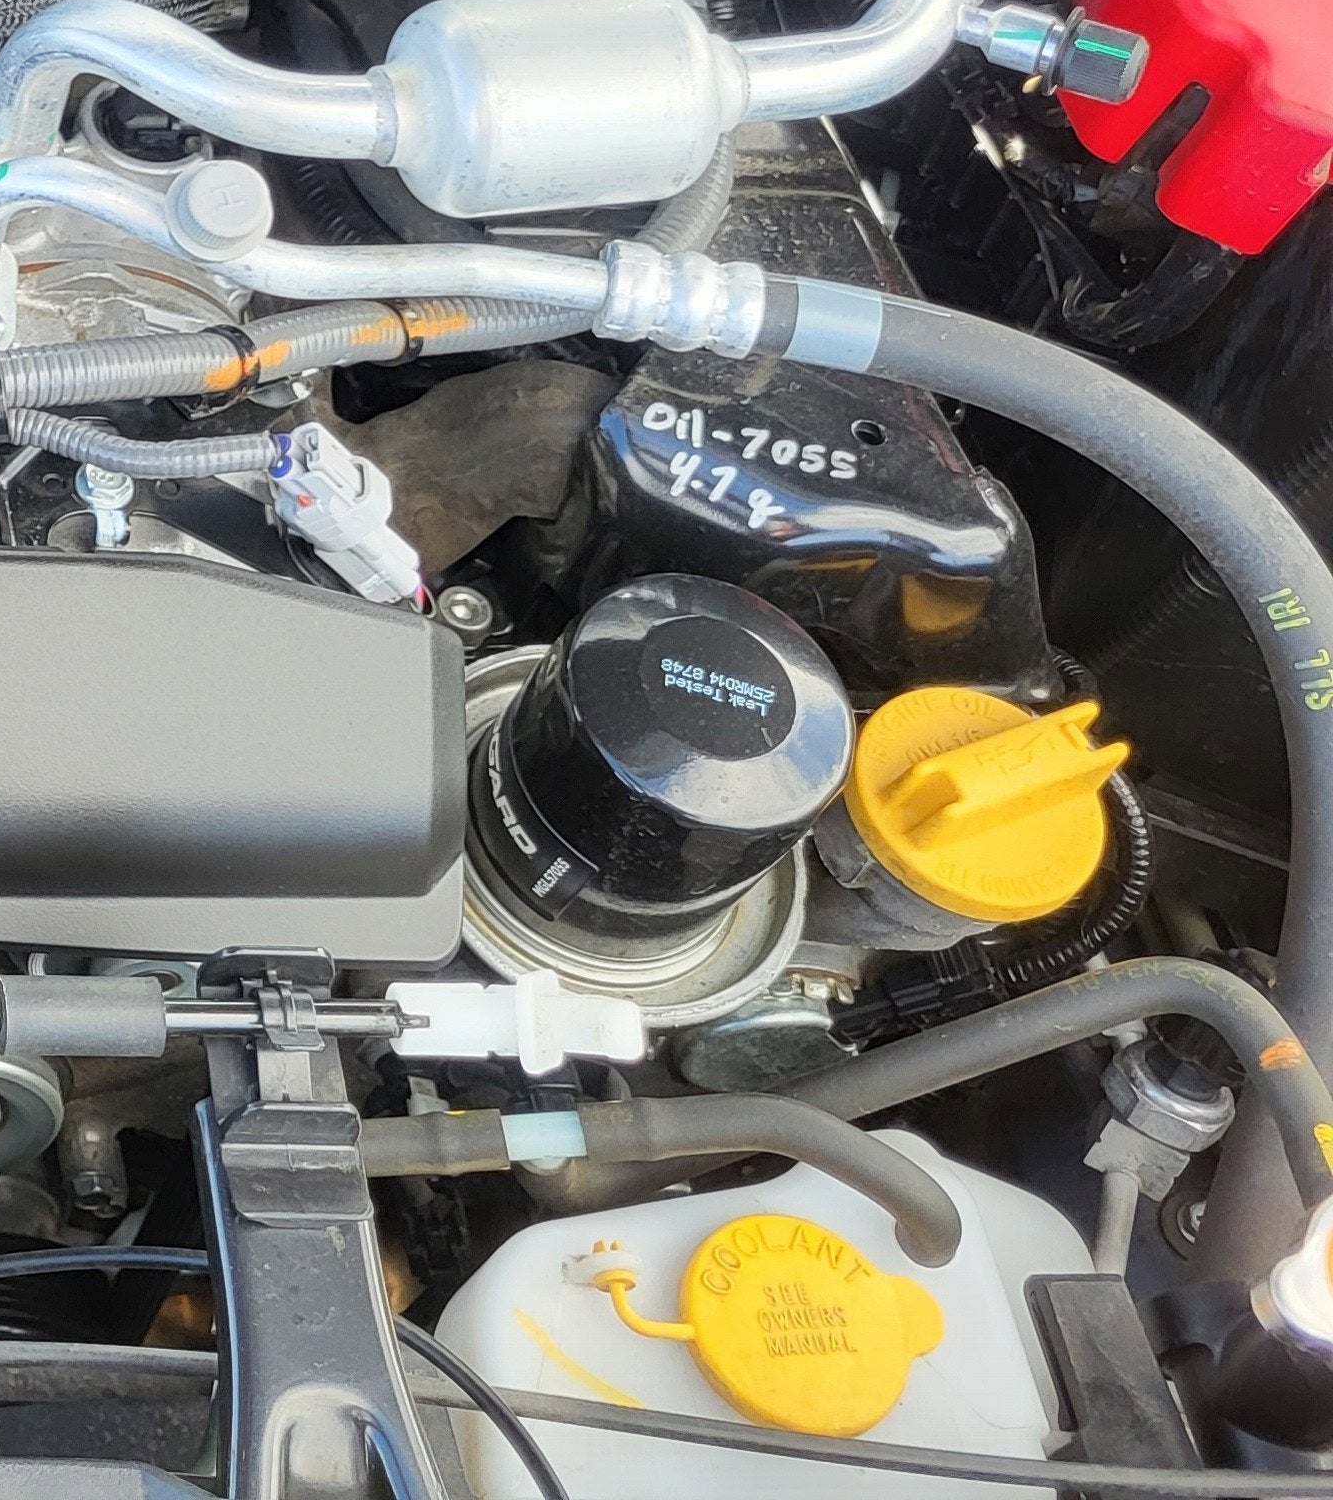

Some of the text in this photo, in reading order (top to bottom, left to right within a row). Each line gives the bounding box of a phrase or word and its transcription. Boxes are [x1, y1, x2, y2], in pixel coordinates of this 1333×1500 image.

[660, 658, 706, 681] 8748
[663, 674, 767, 718] Leak Tested
[701, 1223, 871, 1295] COOLANT
[763, 1280, 812, 1307] SEE
[757, 1306, 848, 1333] OWNERS
[763, 1331, 859, 1359] MANUAL
